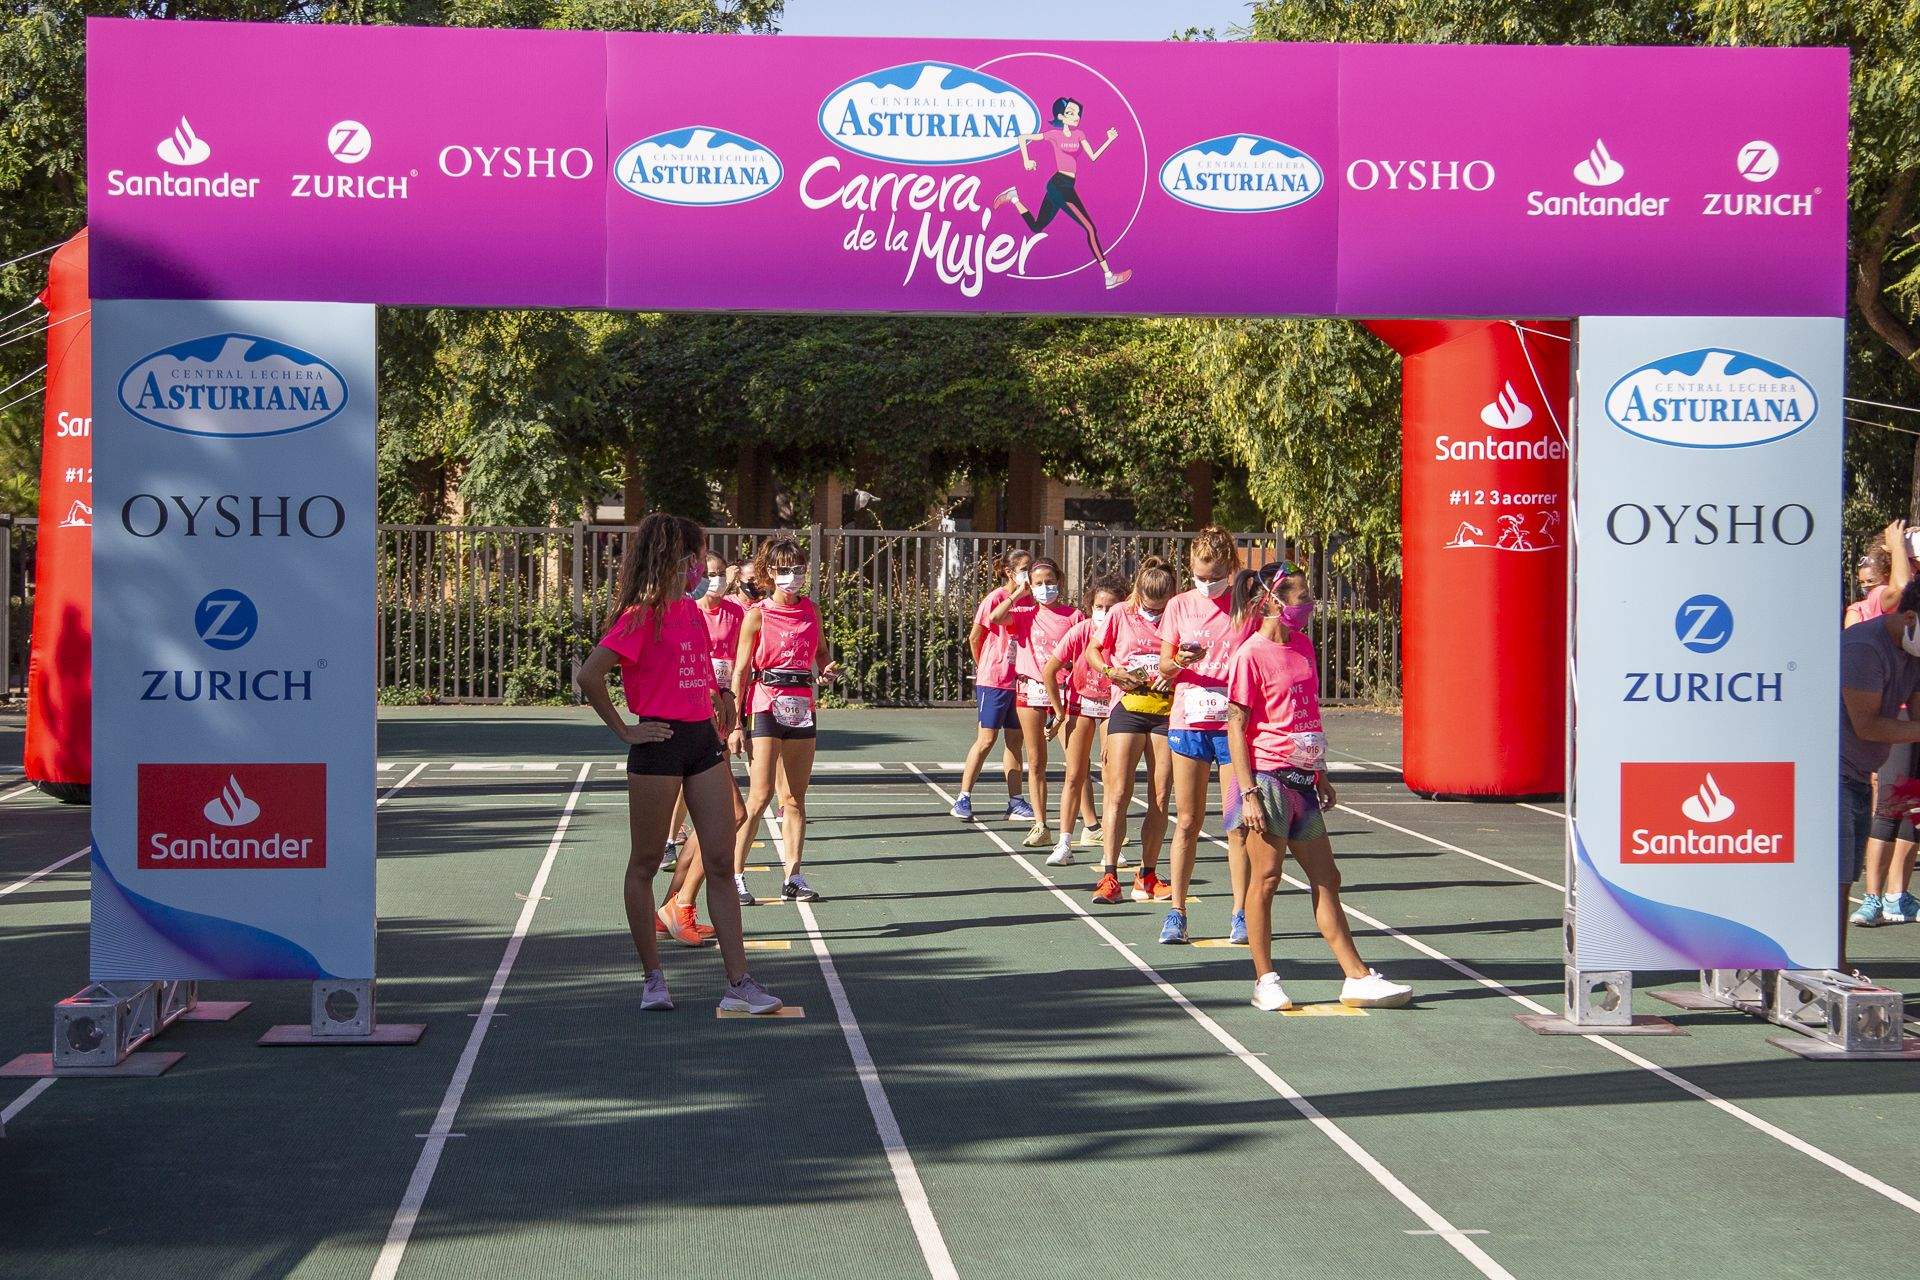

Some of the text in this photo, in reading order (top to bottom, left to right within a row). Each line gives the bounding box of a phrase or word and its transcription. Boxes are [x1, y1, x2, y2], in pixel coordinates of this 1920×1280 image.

[870, 96, 1017, 108] CENTRAL LECHERA
[836, 98, 1022, 138] ASTURIANA
[438, 144, 594, 180] OYSHO
[628, 155, 770, 185] ASTURIANA
[1346, 158, 1496, 192] OYSHO
[107, 169, 260, 198] Santander
[291, 174, 409, 199] ZURICH
[799, 155, 982, 212] Carrera
[1172, 162, 1311, 192] ASTURIANA
[1526, 190, 1670, 217] Santander
[1702, 192, 1813, 216] ZURICH
[843, 207, 1049, 298] de la Mujer
[171, 368, 324, 381] CENTRAL LECHERA
[1655, 382, 1797, 393] CENTRAL LECHERA
[135, 370, 332, 411] ASTURIANA
[1621, 384, 1803, 423] ASTURIANA
[122, 494, 346, 538] OYSHO
[1607, 503, 1815, 546] OYSHO
[680, 642, 693, 651] WE
[1137, 638, 1153, 647] WE
[679, 667, 695, 676] FOR
[680, 653, 708, 664] RUN
[140, 670, 313, 702] ZURICH
[1623, 672, 1783, 702] ZURICH
[151, 832, 313, 860] Santander
[1632, 828, 1783, 855] Santander
